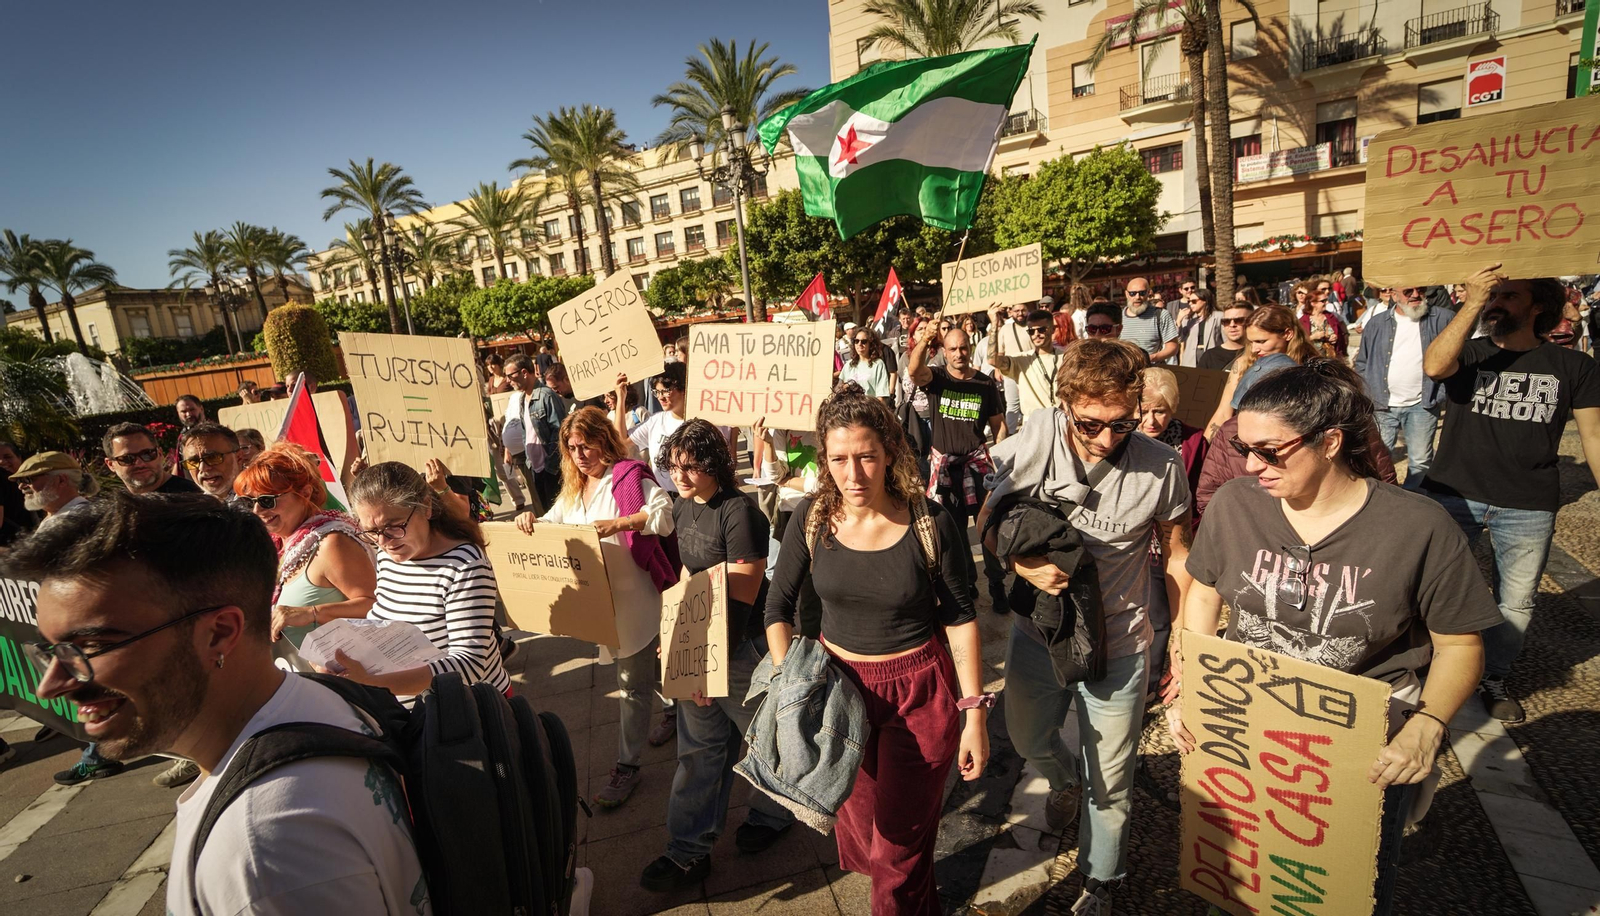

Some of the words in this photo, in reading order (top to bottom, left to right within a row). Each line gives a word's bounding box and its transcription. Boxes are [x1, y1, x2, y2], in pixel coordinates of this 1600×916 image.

[1471, 89, 1500, 103] CGT
[1423, 179, 1458, 206] A
[1496, 165, 1546, 198] TU
[1402, 203, 1584, 248] CASERO
[947, 265, 967, 281] TO
[972, 258, 1000, 278] ESTO
[1002, 249, 1039, 271] ANTES
[950, 285, 975, 306] ERA
[979, 273, 1030, 298] BARRIO
[560, 280, 637, 335] CASEROS
[693, 331, 729, 354] AMA
[349, 353, 473, 389] TURISMO
[569, 339, 638, 382] PARÁSITOS
[768, 364, 797, 381] AL
[939, 405, 948, 414] SE
[941, 397, 950, 406] NO
[951, 399, 959, 408] SE
[367, 412, 473, 449] RUINA
[1078, 508, 1130, 534] Shirt
[508, 552, 581, 570] imperialista
[679, 630, 690, 643] LOS
[1196, 653, 1255, 770] DANOS
[1259, 730, 1333, 847] CASA
[1268, 854, 1330, 916] NA
